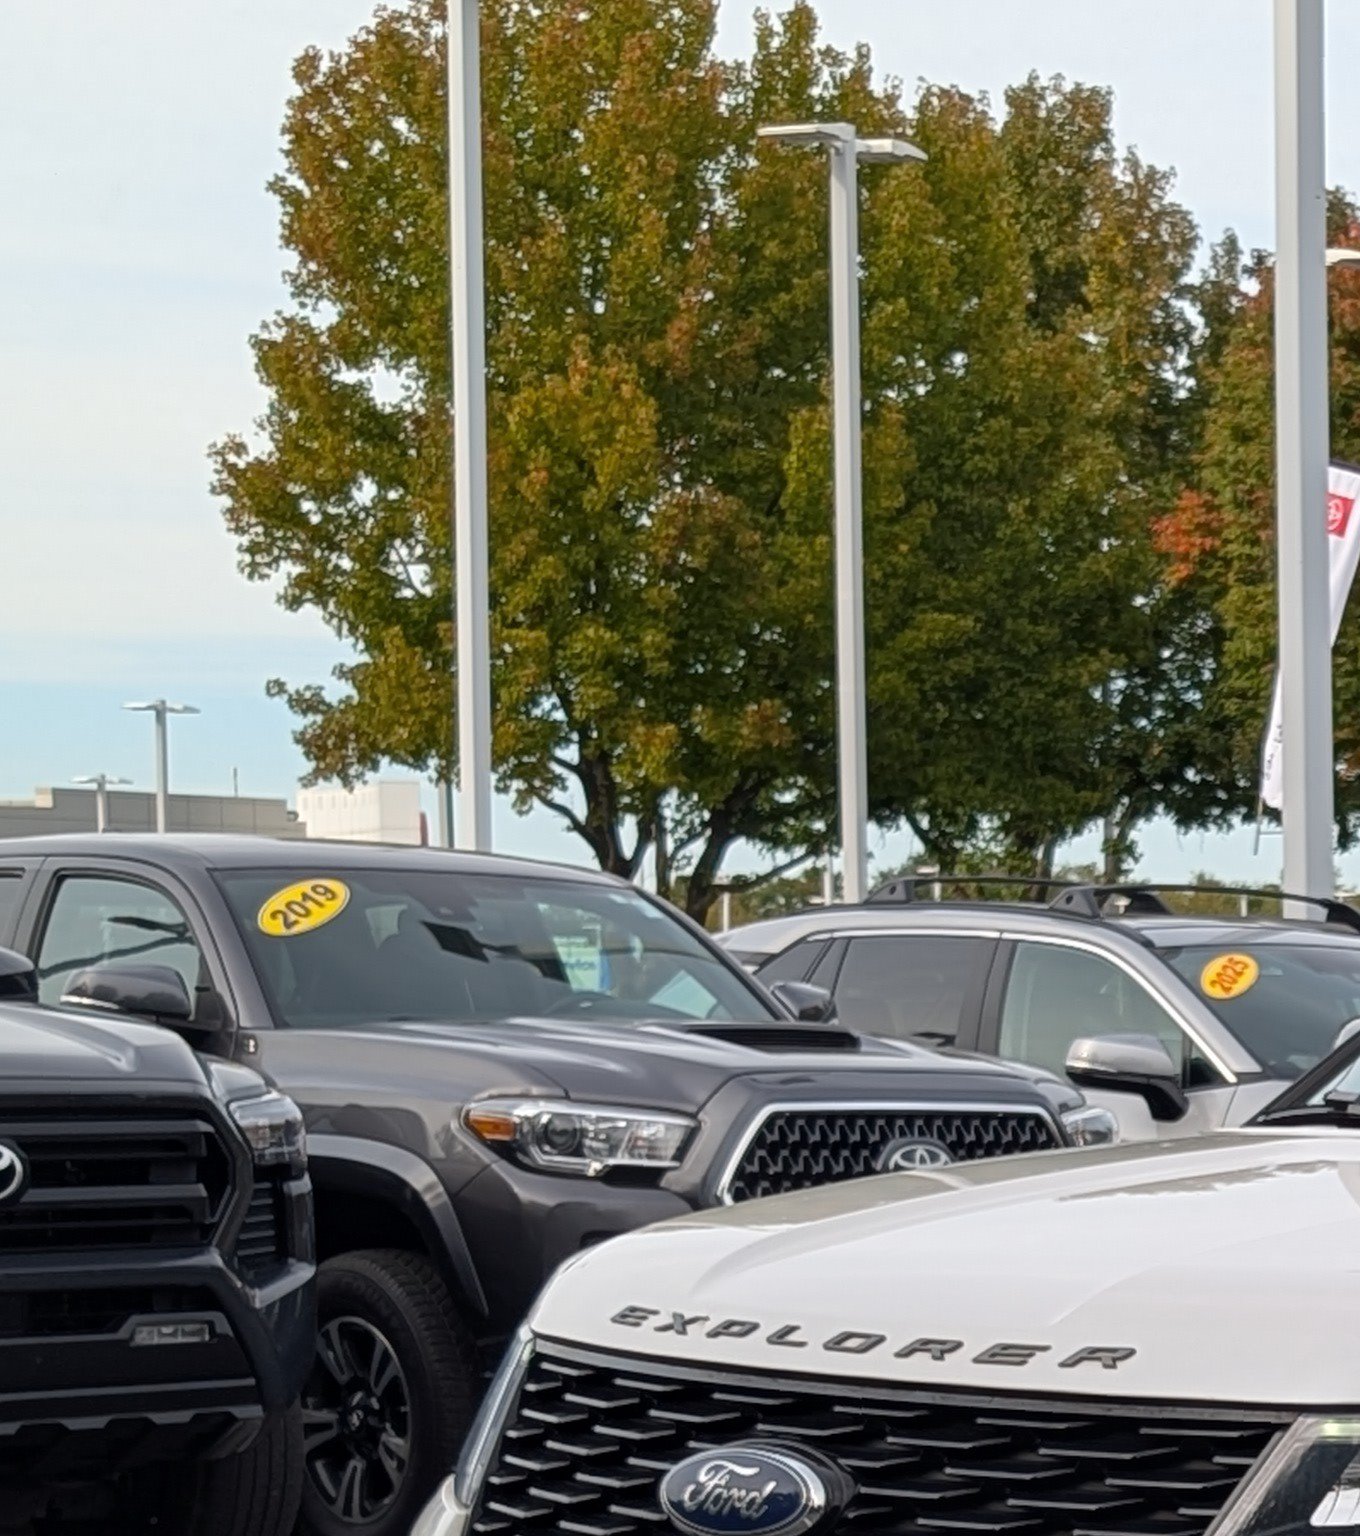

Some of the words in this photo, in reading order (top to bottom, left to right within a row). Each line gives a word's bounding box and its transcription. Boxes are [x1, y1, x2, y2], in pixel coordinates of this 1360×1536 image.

[269, 883, 338, 931] 2019
[609, 1305, 1138, 1370] EXPLORER
[682, 1459, 778, 1520] Ford
